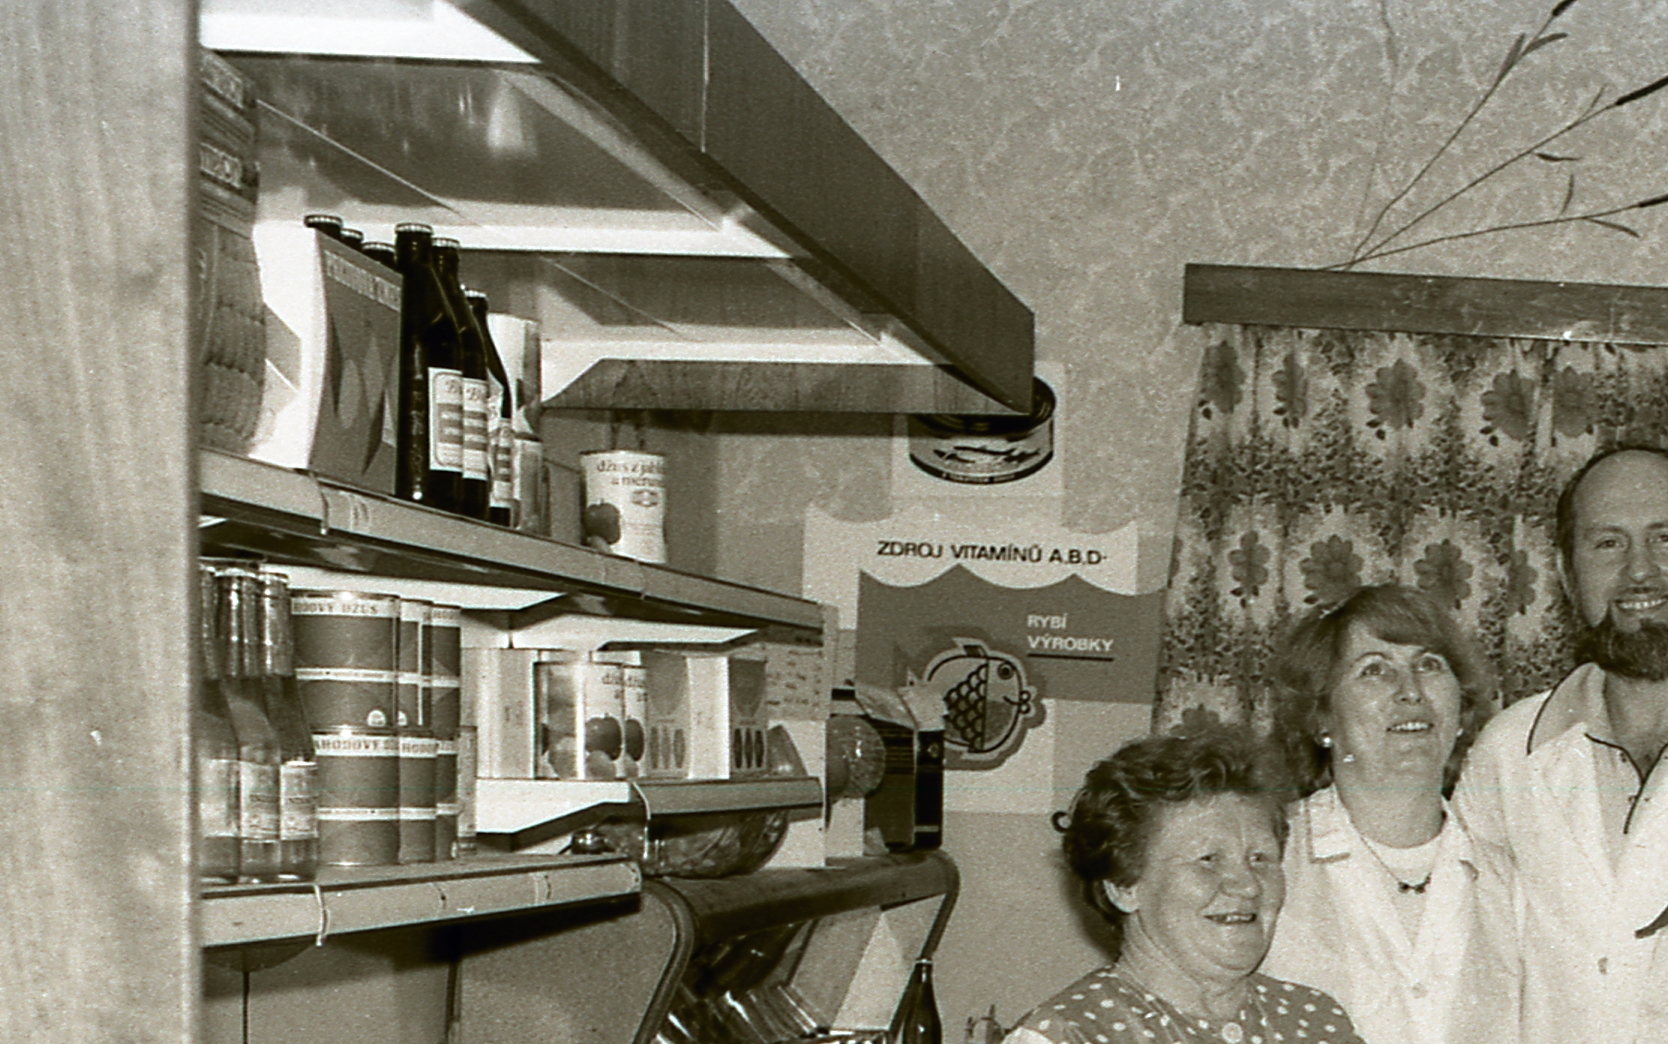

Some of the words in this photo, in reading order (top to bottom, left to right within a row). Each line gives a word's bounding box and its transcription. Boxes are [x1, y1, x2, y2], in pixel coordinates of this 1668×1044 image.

[877, 540, 944, 559] ZDROJ
[950, 543, 1042, 563] VITAMÍNŮ
[1027, 612, 1067, 629] RYBÍ
[1026, 635, 1113, 652] VÝROBKY
